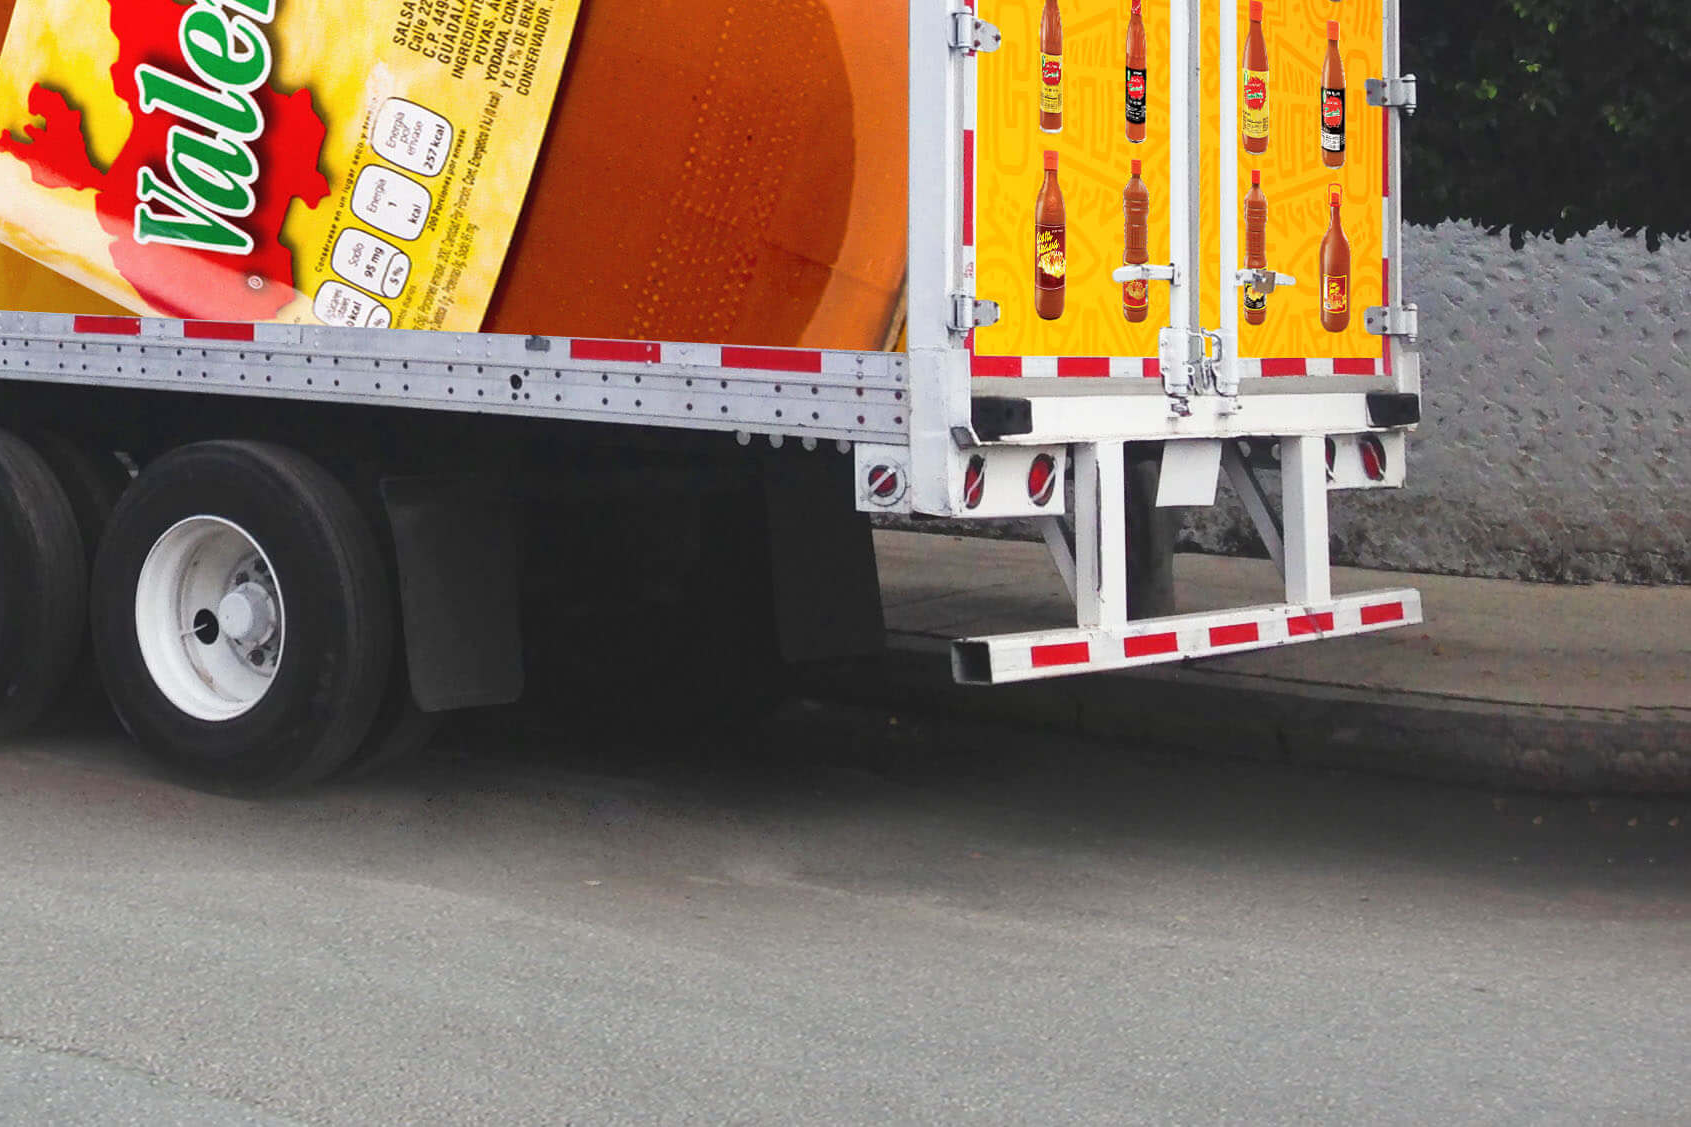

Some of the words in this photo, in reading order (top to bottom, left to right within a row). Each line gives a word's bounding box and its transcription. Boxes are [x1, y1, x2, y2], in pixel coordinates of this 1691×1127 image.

[392, 1, 416, 46] SALSA
[407, 18, 428, 51] Calle
[423, 31, 441, 58] C.P.
[501, 81, 513, 89] Y
[512, 29, 527, 46] DE
[430, 123, 445, 147] kcal
[424, 148, 437, 169] 257
[427, 215, 438, 231] 200
[447, 159, 457, 175] por
[407, 203, 421, 224] kcal
[348, 242, 364, 267] Sodio
[364, 264, 375, 278] 95
[370, 246, 384, 264] mg
[349, 301, 361, 320] kcal
